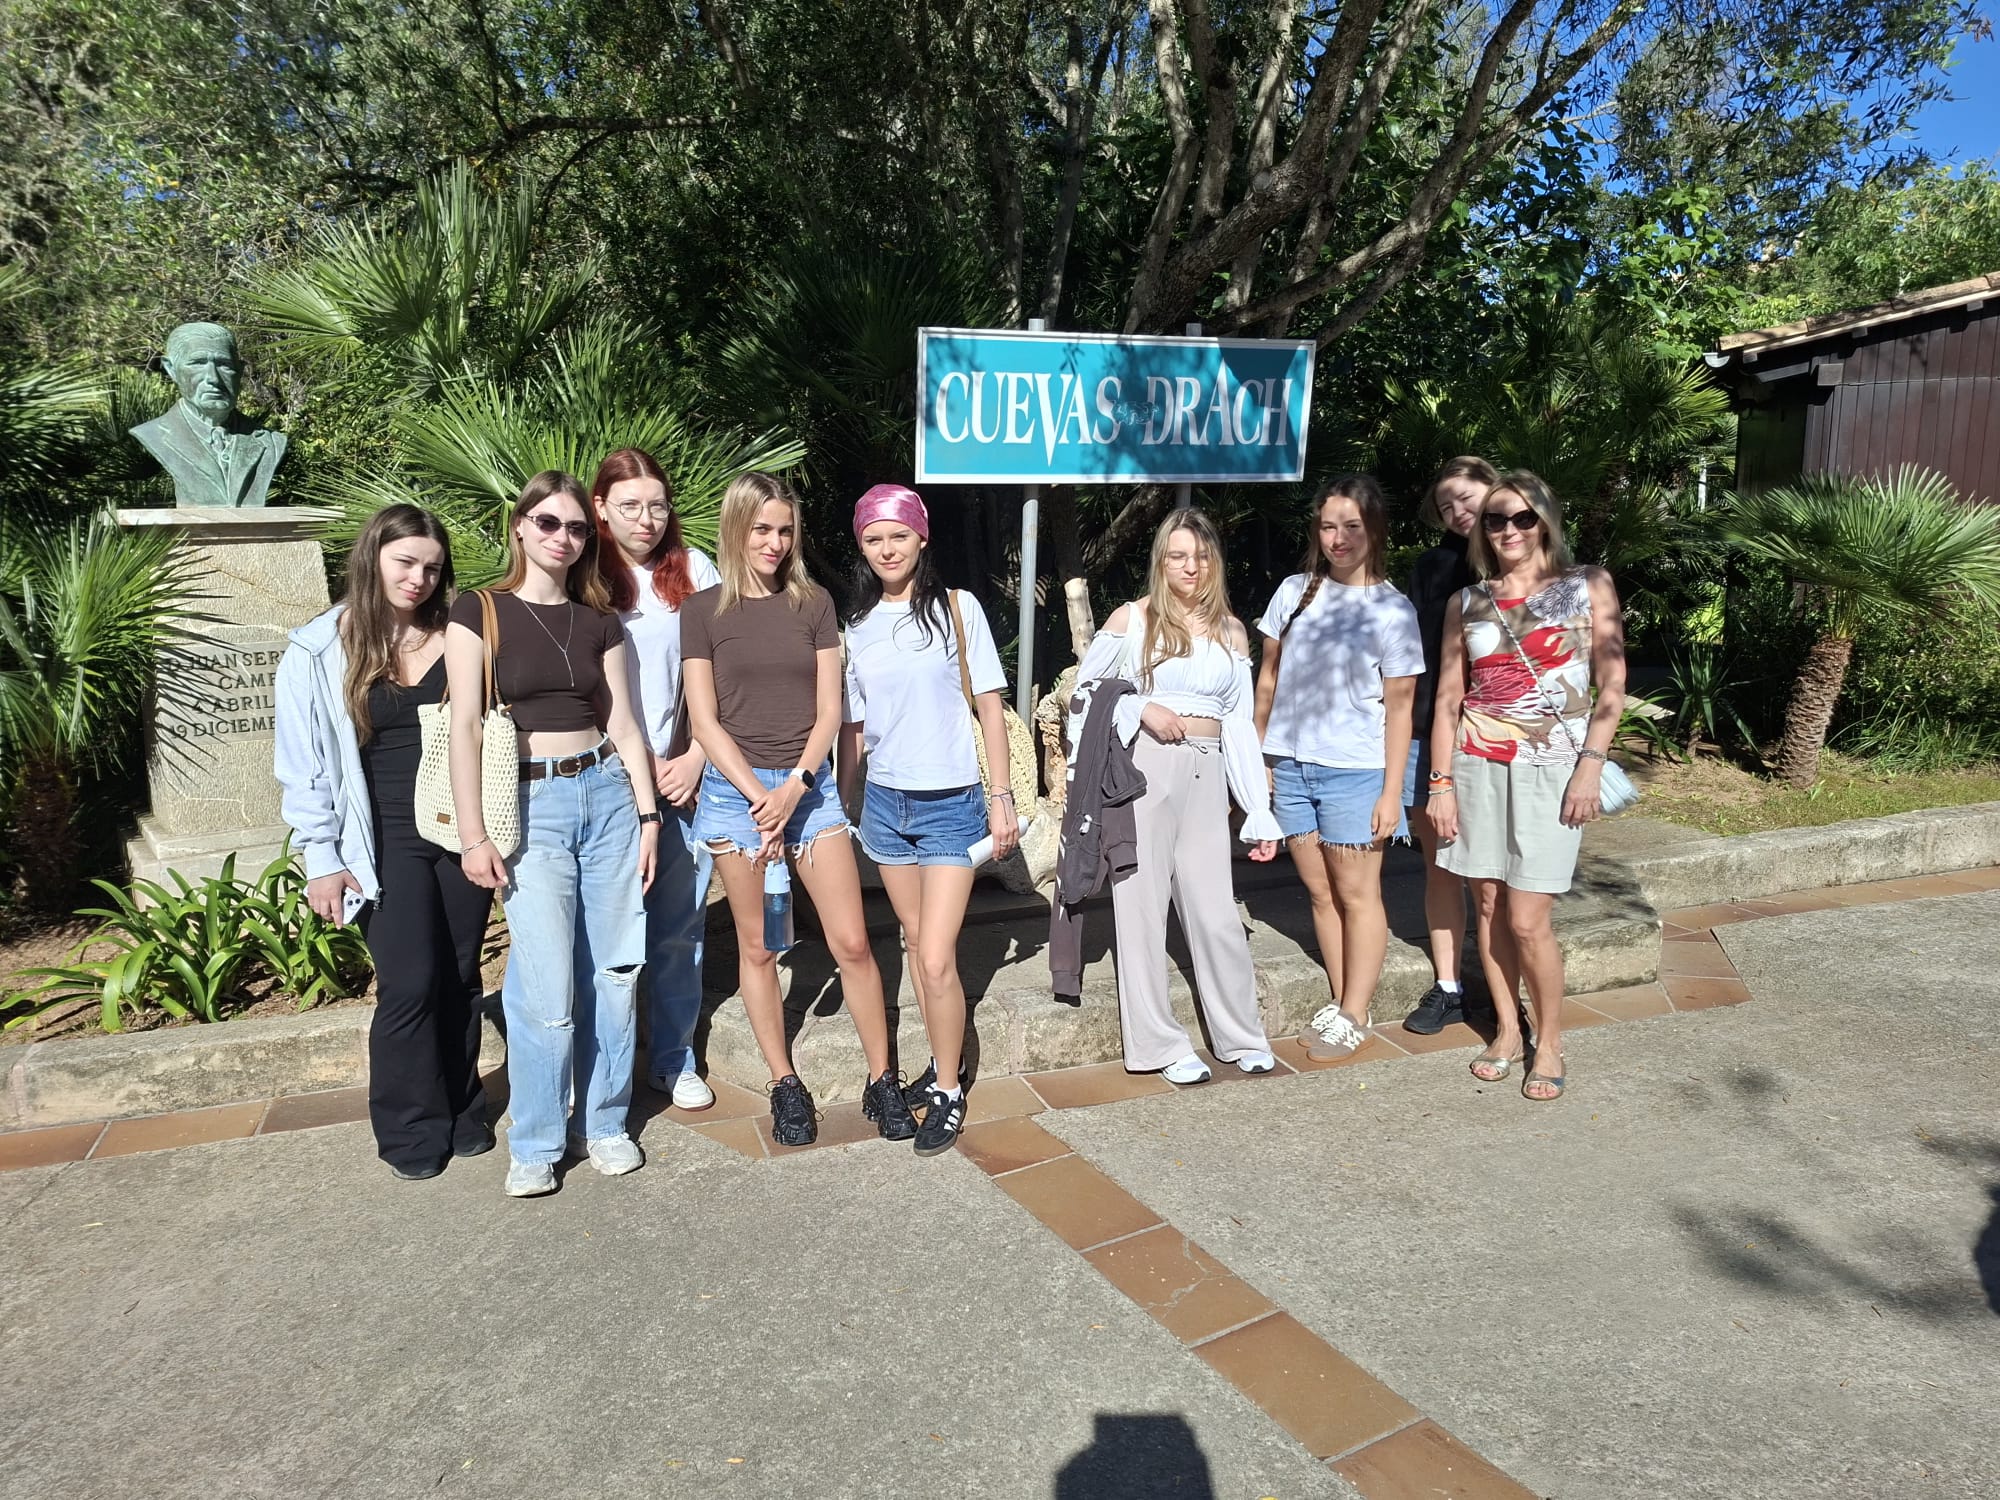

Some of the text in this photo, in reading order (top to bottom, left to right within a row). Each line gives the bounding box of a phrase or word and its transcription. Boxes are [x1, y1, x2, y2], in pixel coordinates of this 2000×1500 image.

[935, 358, 1293, 467] CUEVAS DRACH
[243, 650, 286, 666] SER
[211, 695, 275, 713] ABRIL
